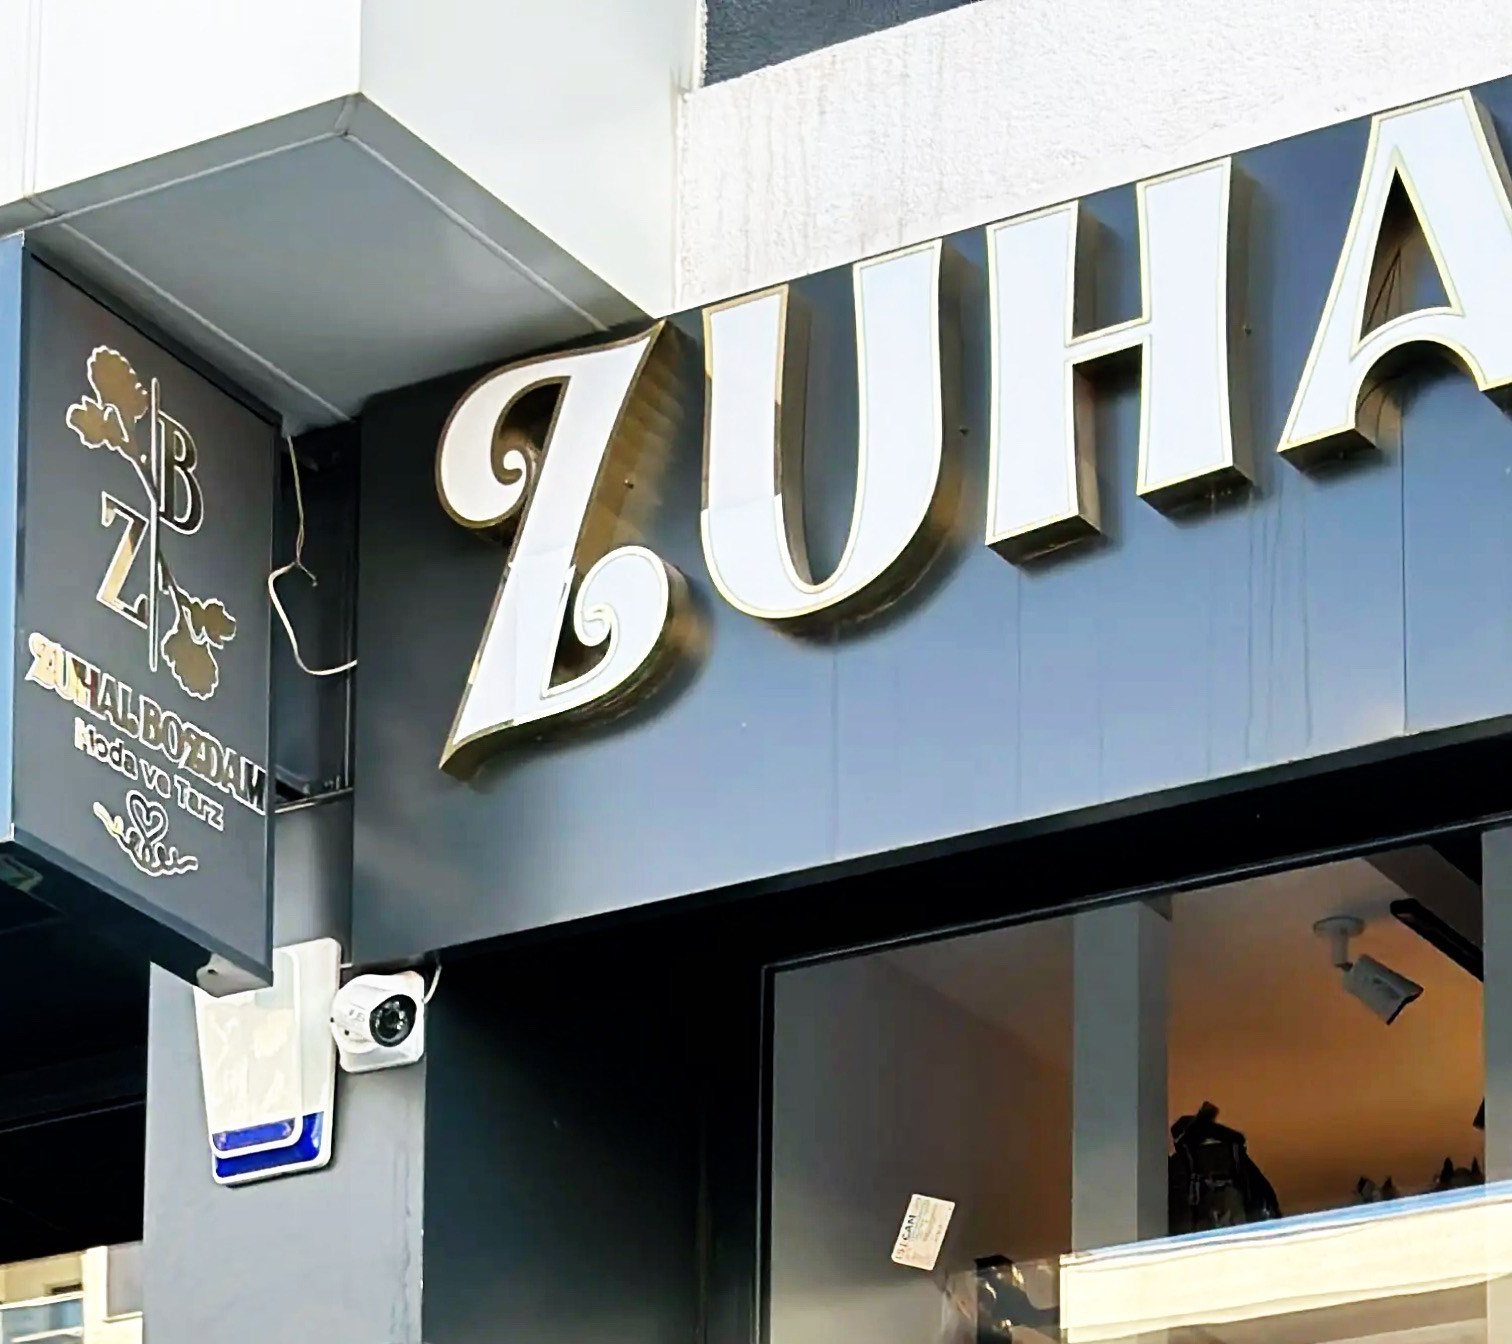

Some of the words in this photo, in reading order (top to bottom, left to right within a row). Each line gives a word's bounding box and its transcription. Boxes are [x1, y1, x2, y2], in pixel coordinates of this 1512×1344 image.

[156, 410, 204, 535] B
[437, 89, 1512, 772] ZUHA
[95, 490, 149, 629] Z
[25, 632, 139, 738] ZUHAL
[74, 717, 139, 781] Moda
[139, 758, 172, 799] ve
[174, 773, 225, 831] Tarz
